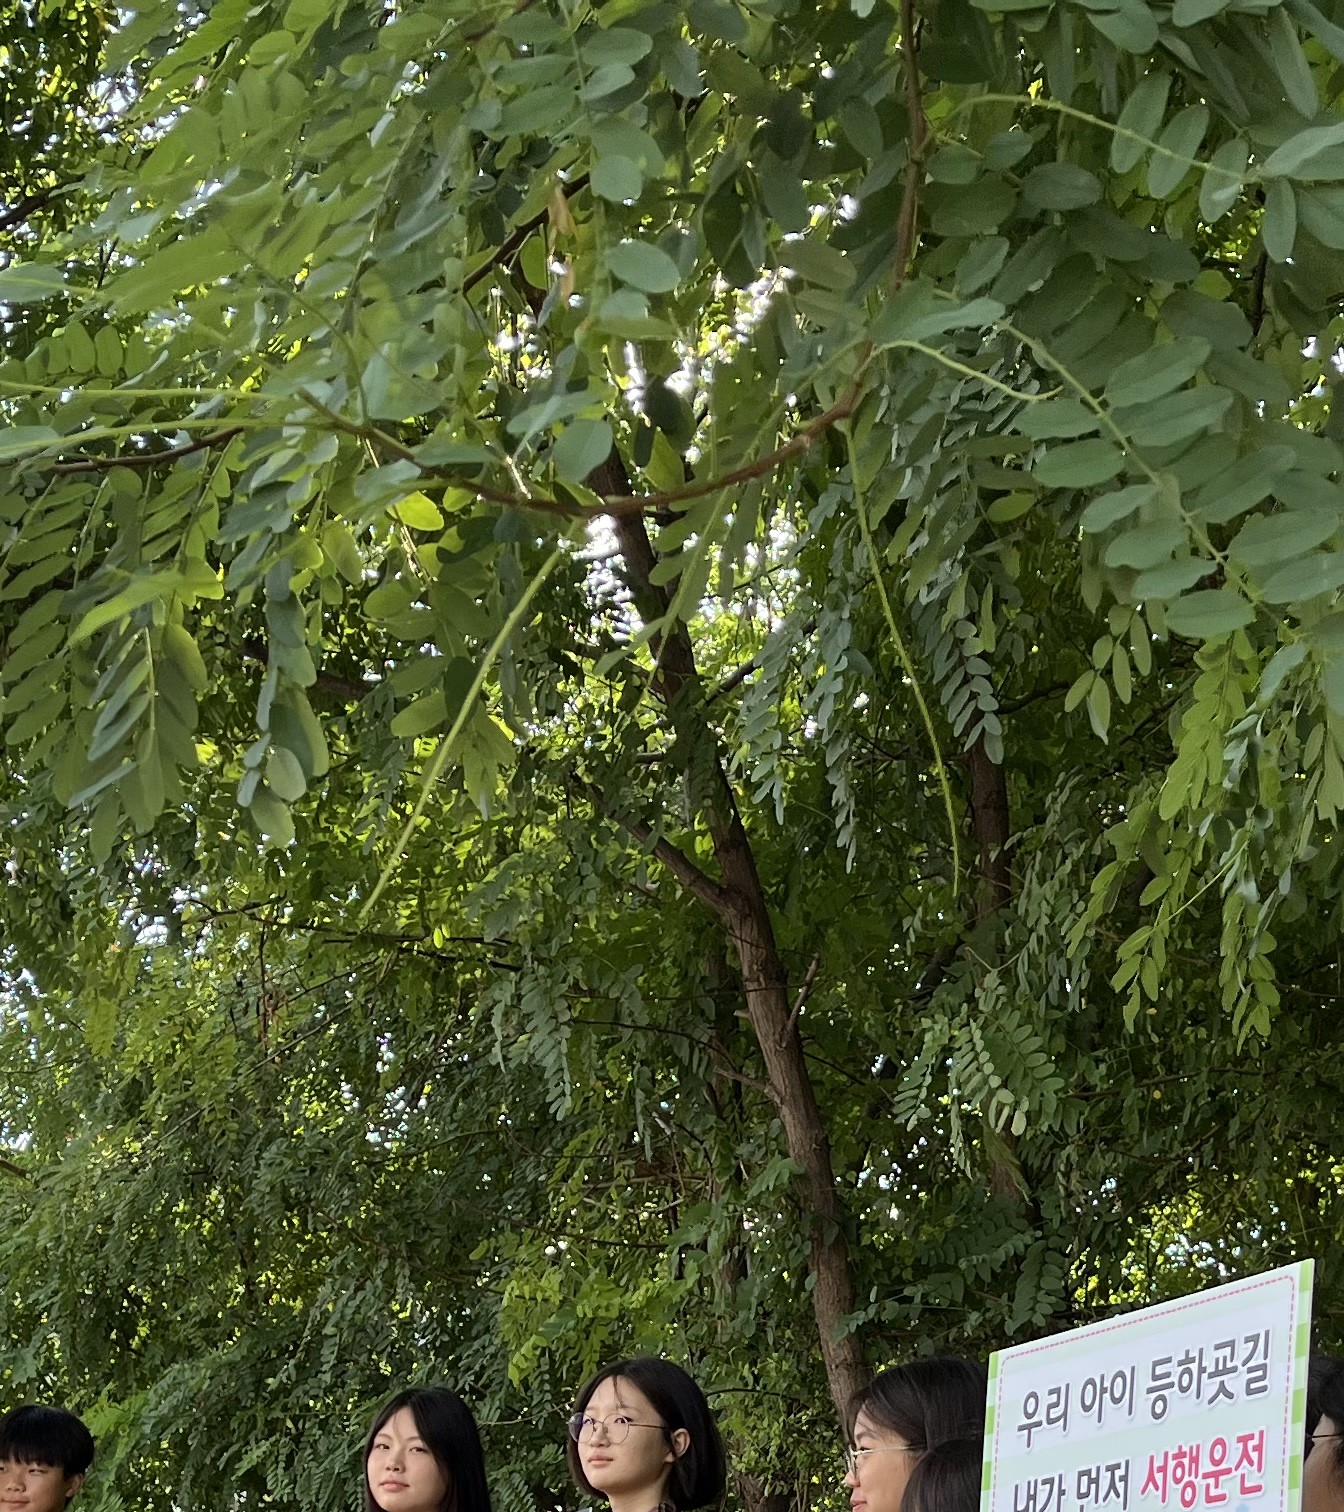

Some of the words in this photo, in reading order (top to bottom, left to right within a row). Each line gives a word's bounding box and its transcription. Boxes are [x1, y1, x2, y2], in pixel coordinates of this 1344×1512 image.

[1017, 1382, 1071, 1448] 우리
[1080, 1365, 1135, 1424] 아이
[1146, 1329, 1271, 1420] 등하굣길
[1140, 1429, 1265, 1508] 서행운전
